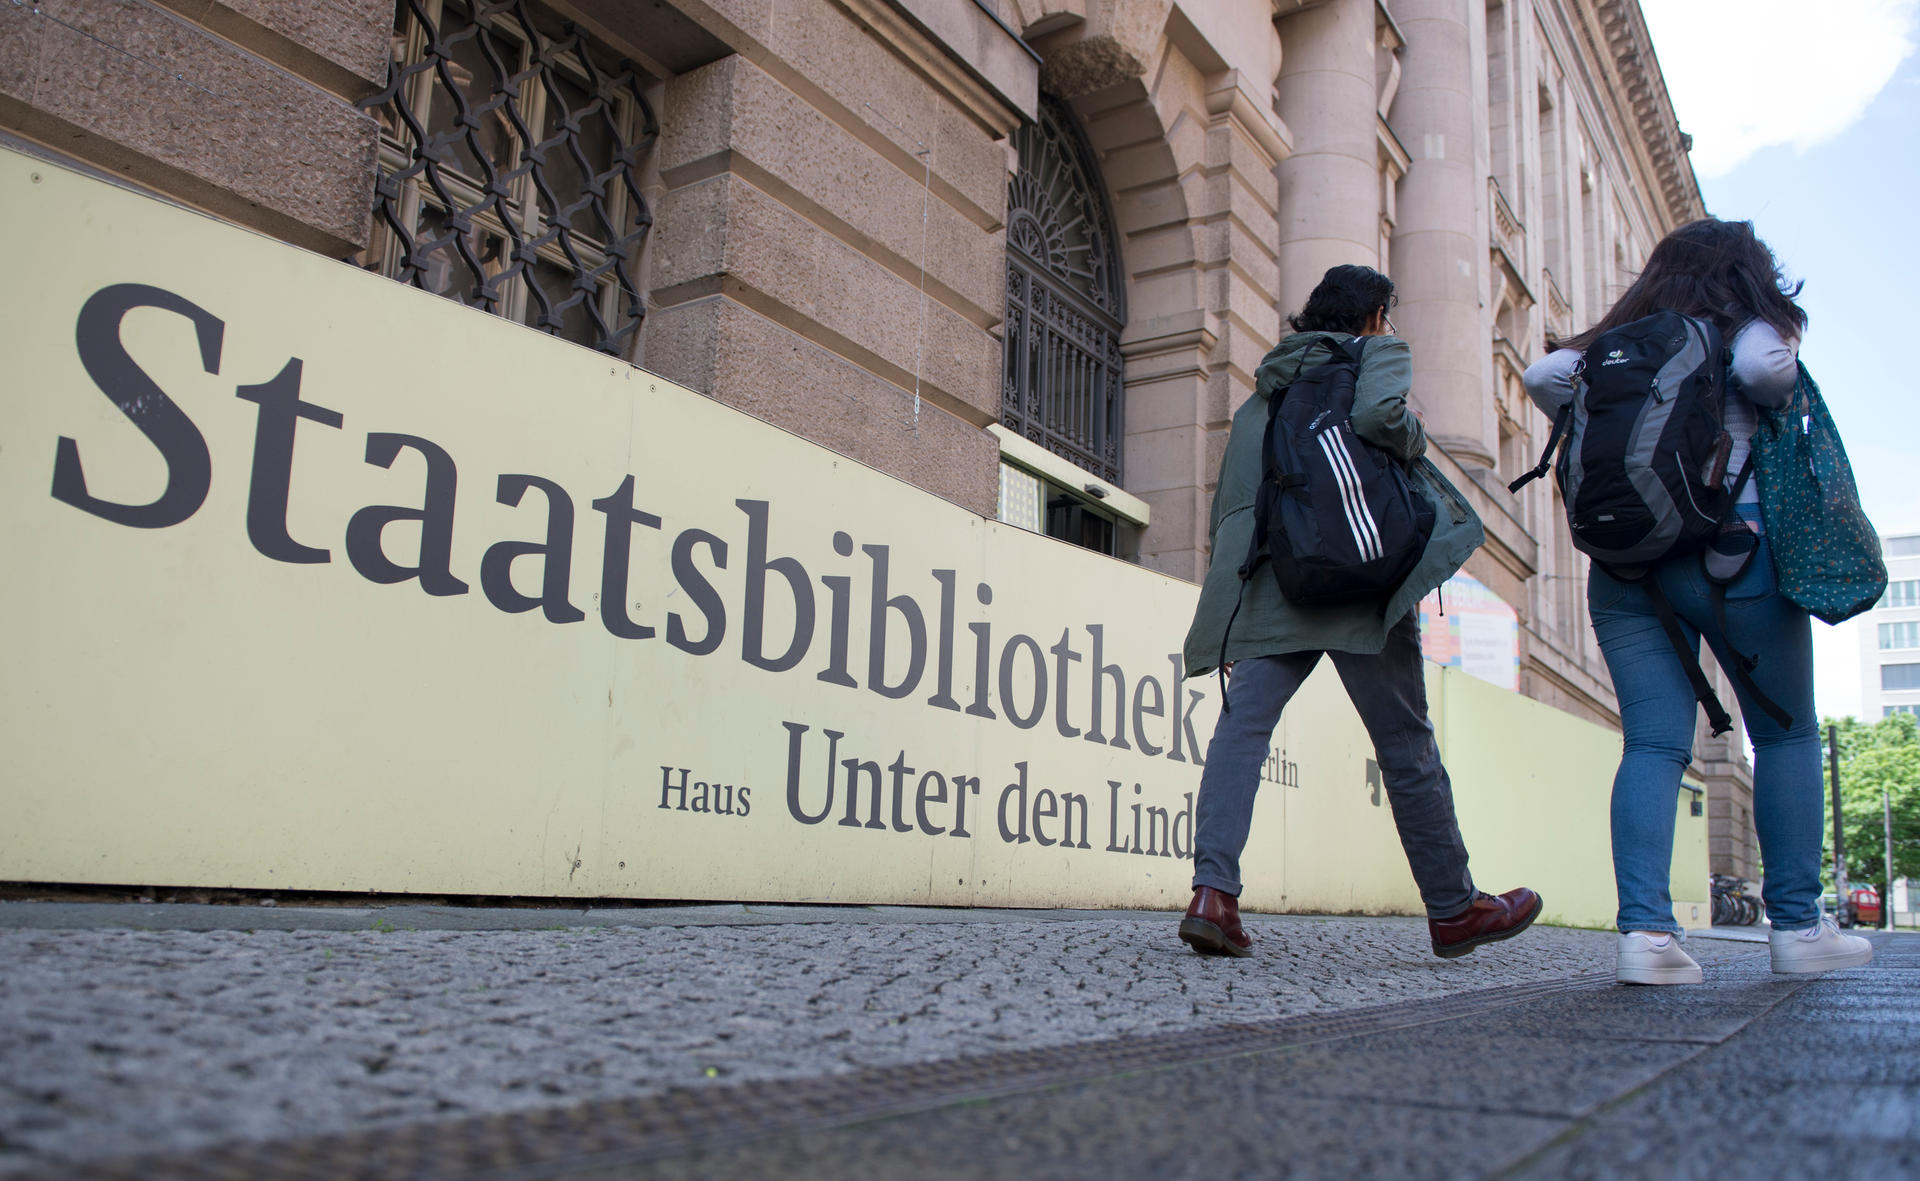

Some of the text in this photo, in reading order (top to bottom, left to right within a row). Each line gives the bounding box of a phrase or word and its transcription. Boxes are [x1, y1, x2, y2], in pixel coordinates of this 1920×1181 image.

[51, 283, 1205, 767] Staatsbibliothek
[658, 720, 1195, 860] Haus Unter den Lind
